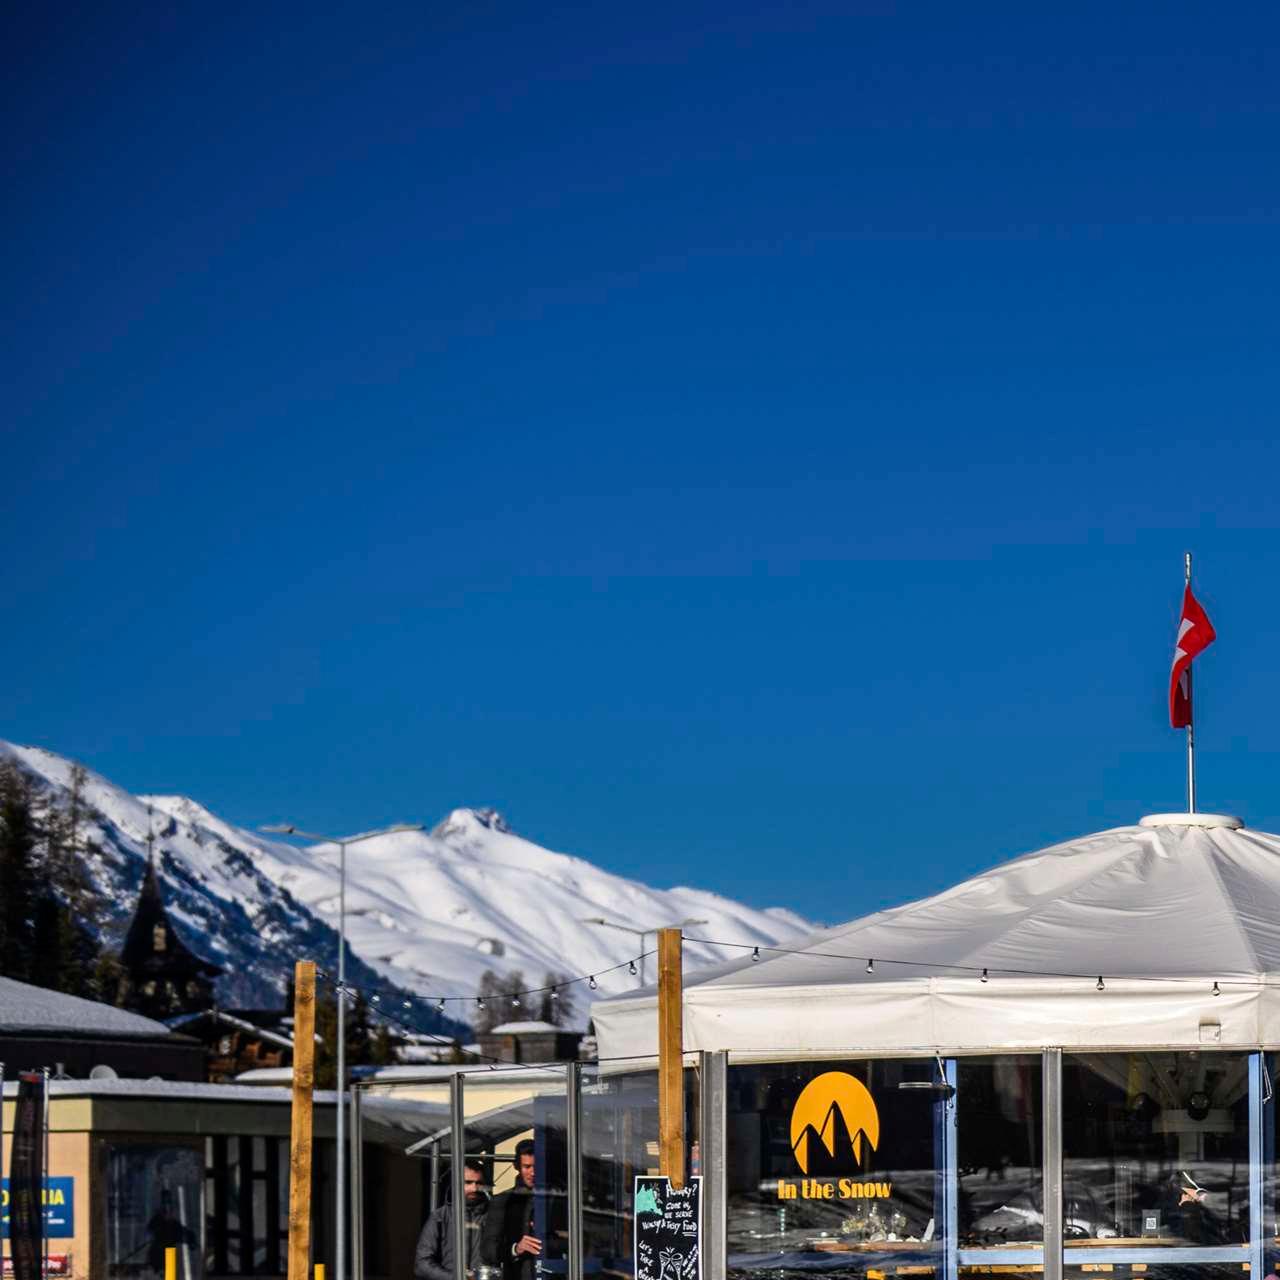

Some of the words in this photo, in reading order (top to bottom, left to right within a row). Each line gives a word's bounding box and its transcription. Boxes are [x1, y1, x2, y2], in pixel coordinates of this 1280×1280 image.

[778, 1179, 797, 1199] In
[802, 1179, 834, 1199] the
[838, 1178, 892, 1199] Snow
